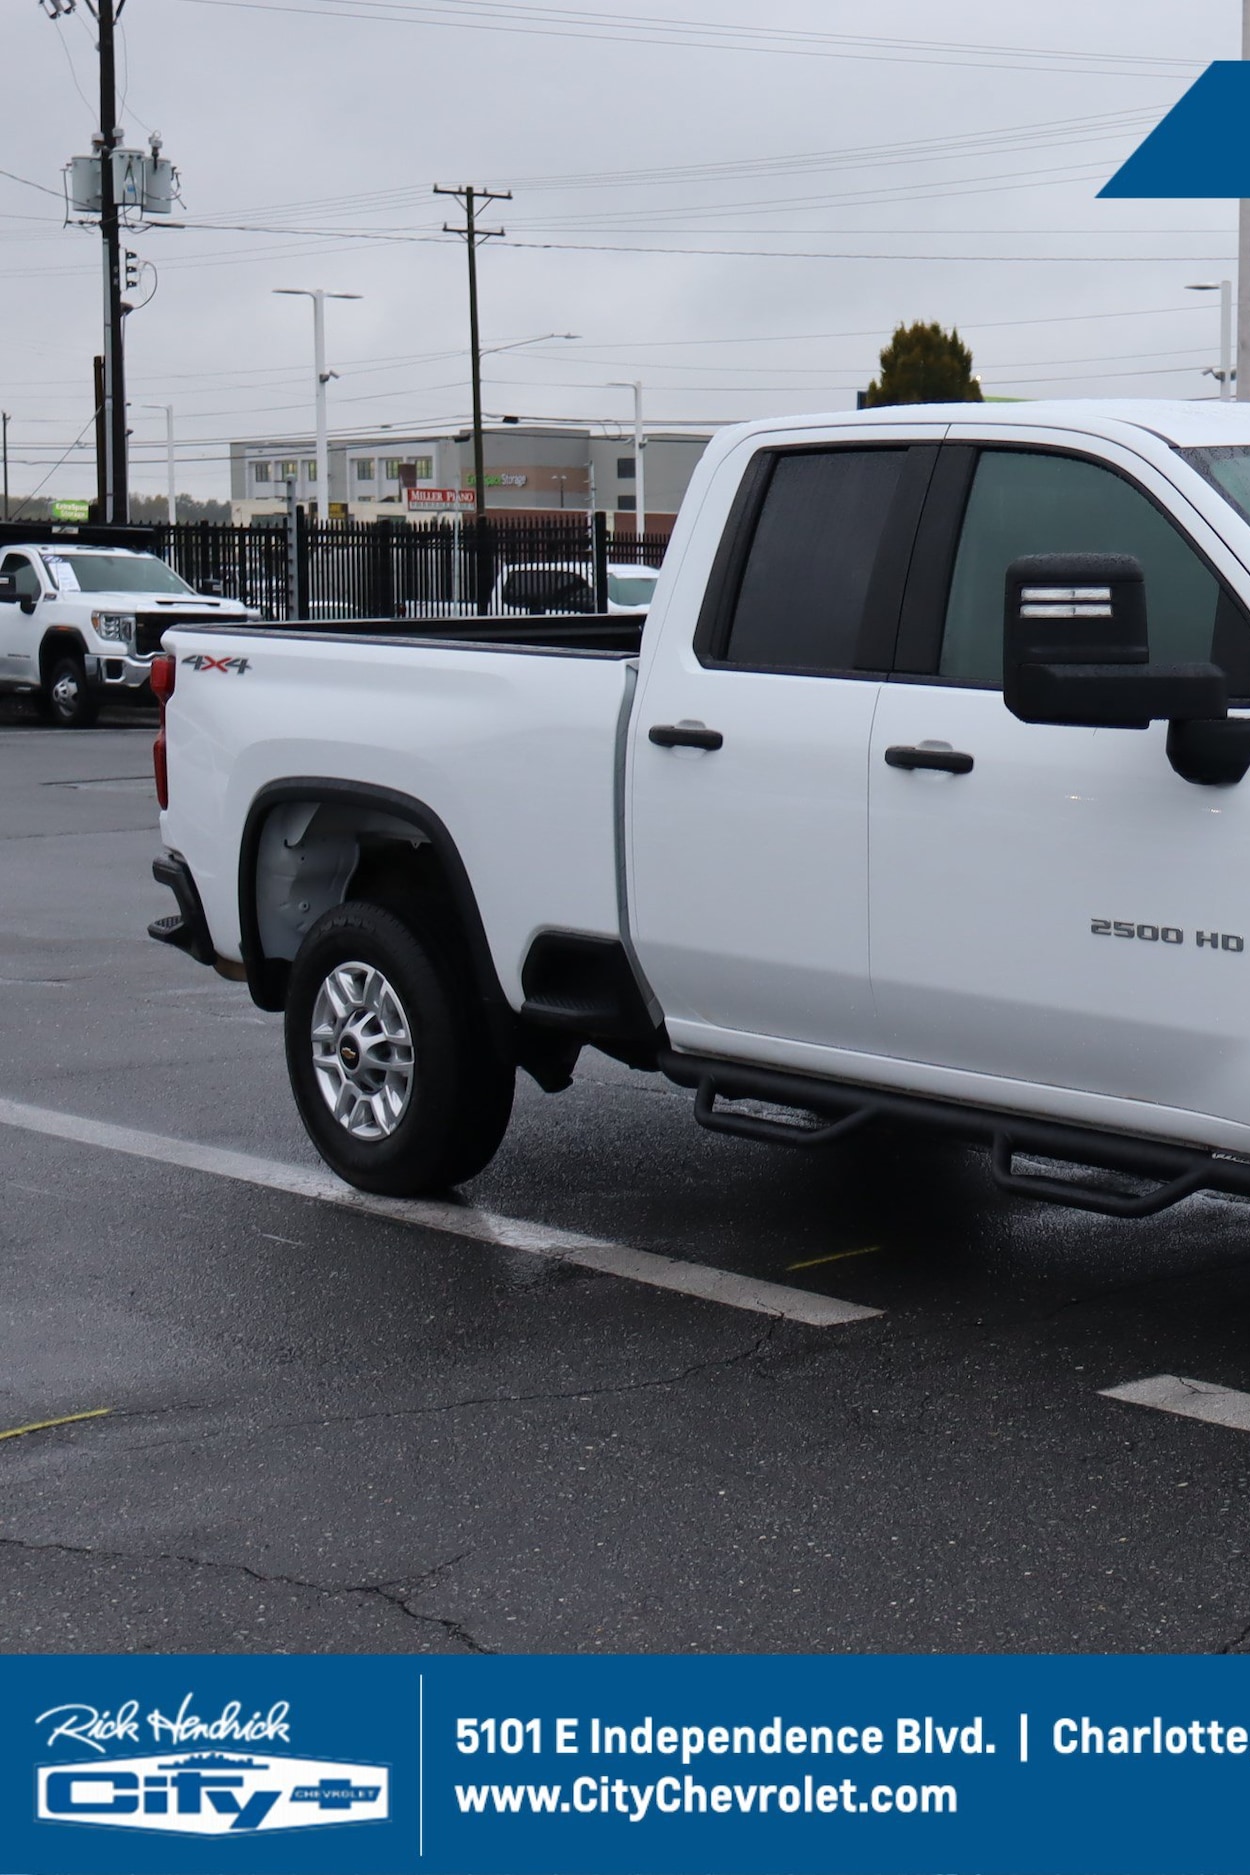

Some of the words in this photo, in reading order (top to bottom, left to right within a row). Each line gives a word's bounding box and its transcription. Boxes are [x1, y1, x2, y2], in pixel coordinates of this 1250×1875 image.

[411, 489, 443, 501] MILLER
[1091, 918, 1183, 944] 2500
[1196, 930, 1244, 952] HD
